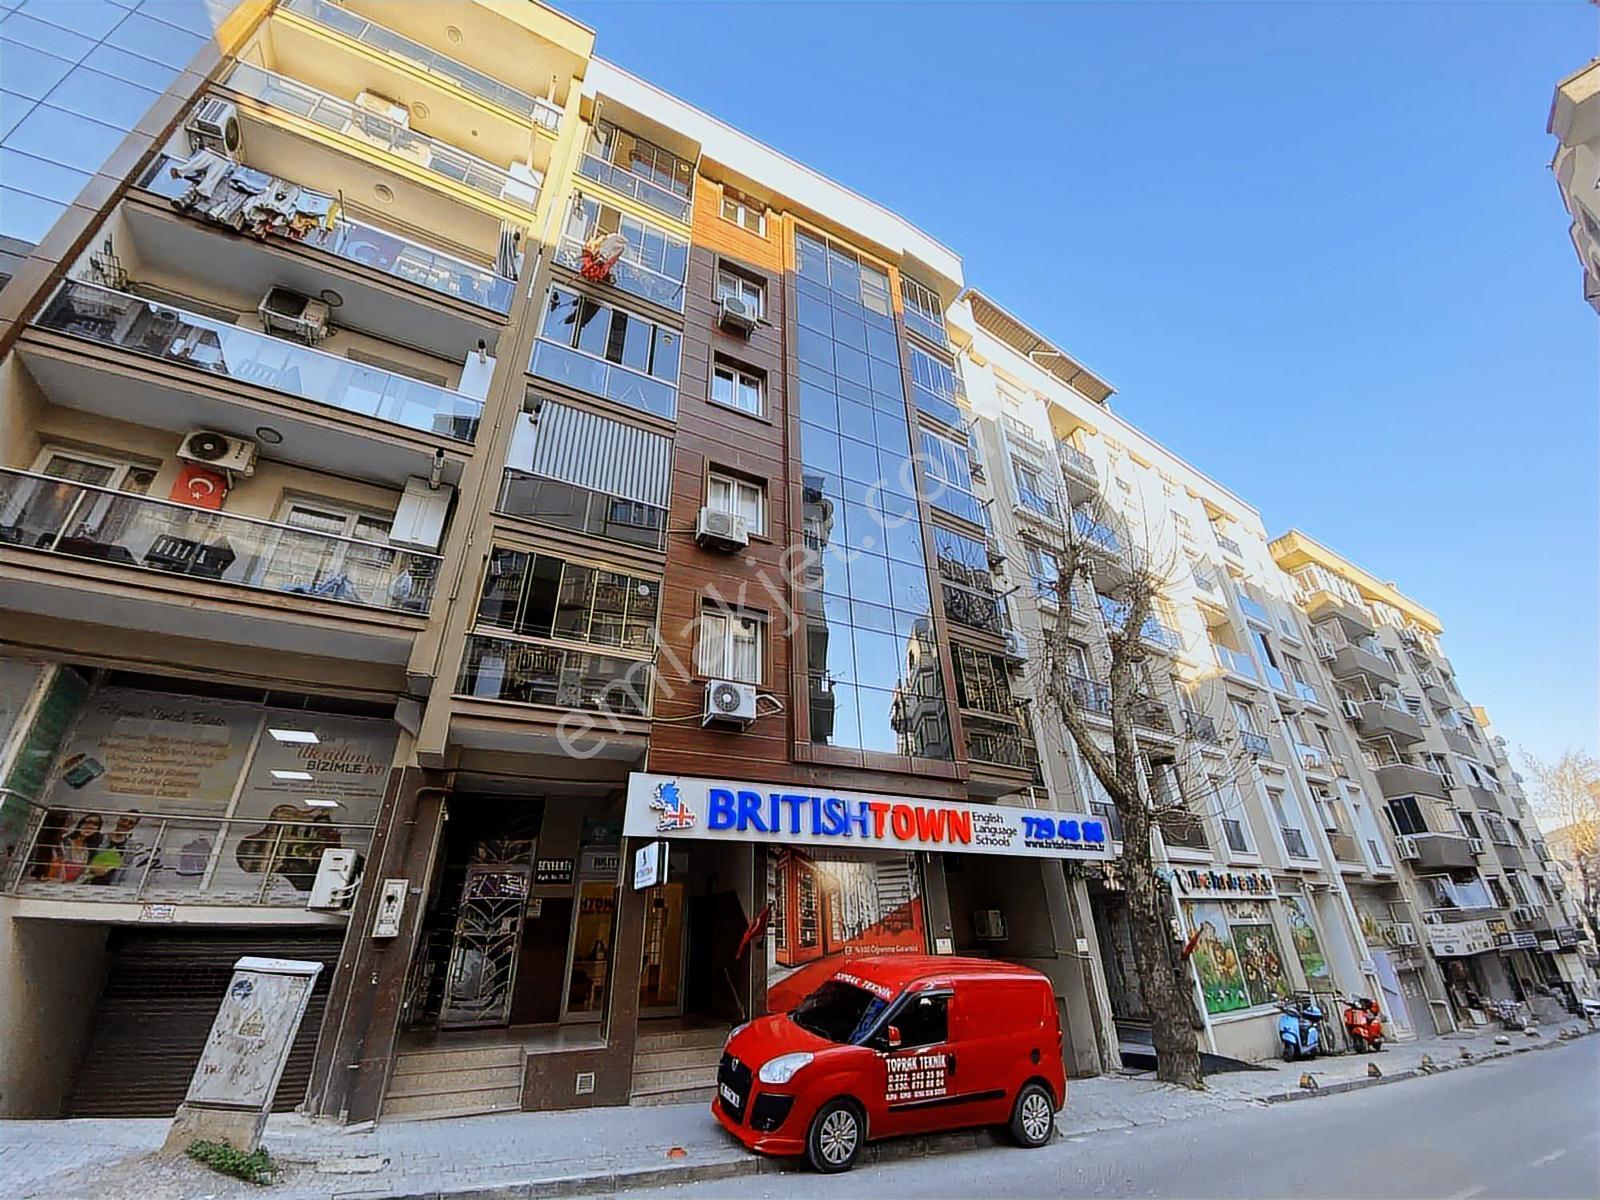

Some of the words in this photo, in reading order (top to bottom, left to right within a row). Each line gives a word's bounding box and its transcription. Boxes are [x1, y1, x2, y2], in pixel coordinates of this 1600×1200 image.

[972, 811, 1004, 824] English
[973, 823, 1018, 838] Language
[975, 834, 1011, 848] Schools
[886, 1057, 918, 1072] TOPRAK
